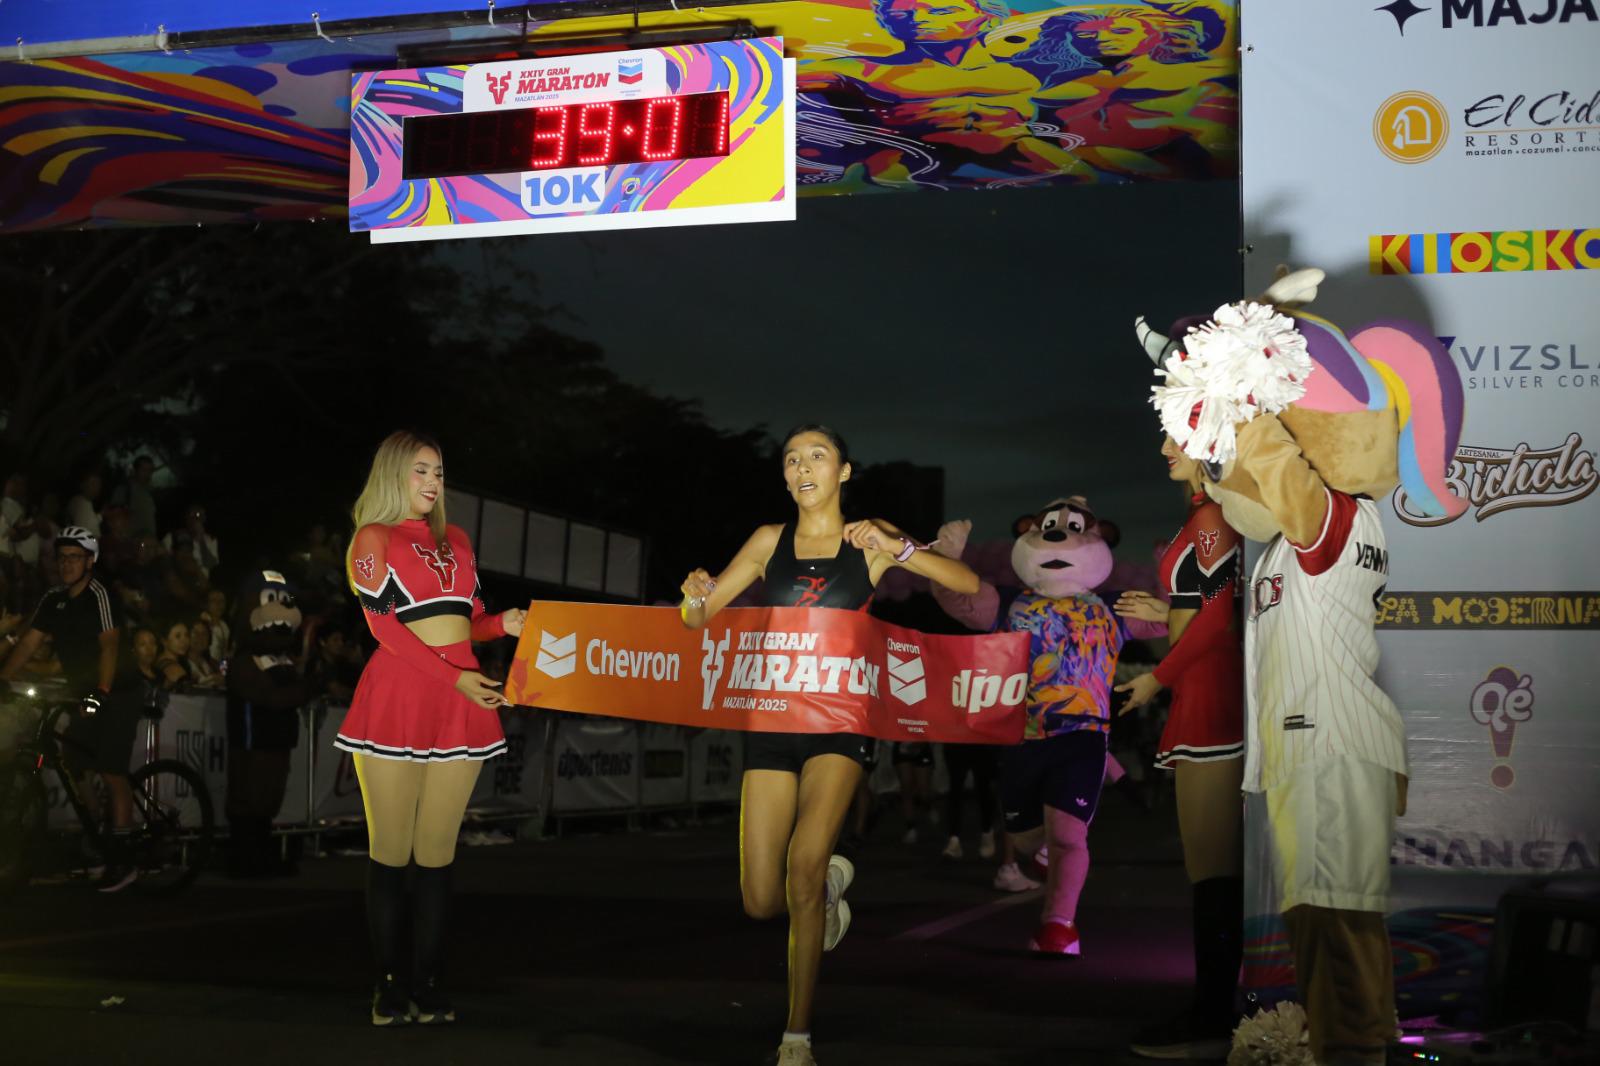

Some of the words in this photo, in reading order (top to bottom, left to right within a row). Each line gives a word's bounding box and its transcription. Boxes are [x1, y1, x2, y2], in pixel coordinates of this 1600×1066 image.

[520, 69, 544, 79] XXIV
[547, 66, 570, 76] GRAN
[516, 71, 610, 95] MARATÓN
[545, 92, 560, 101] 2025
[1464, 94, 1526, 128] El
[1528, 90, 1600, 127] Cid
[1465, 131, 1600, 147] RESORT
[1465, 147, 1513, 157] mazatlan
[1521, 145, 1564, 155] cozumel
[525, 172, 601, 207] 10K
[1459, 344, 1600, 371] VIZSL
[1469, 375, 1544, 389] SILVER
[1558, 374, 1600, 389] COR
[1432, 596, 1600, 625] MODERNA
[737, 632, 765, 651] XXIV
[763, 632, 820, 651] GRAN
[887, 637, 921, 655] Chevron
[585, 638, 681, 682] Chevron
[722, 694, 757, 710] MAZATLÁN
[757, 698, 788, 711] 2025
[1391, 836, 1600, 871] HANGA
